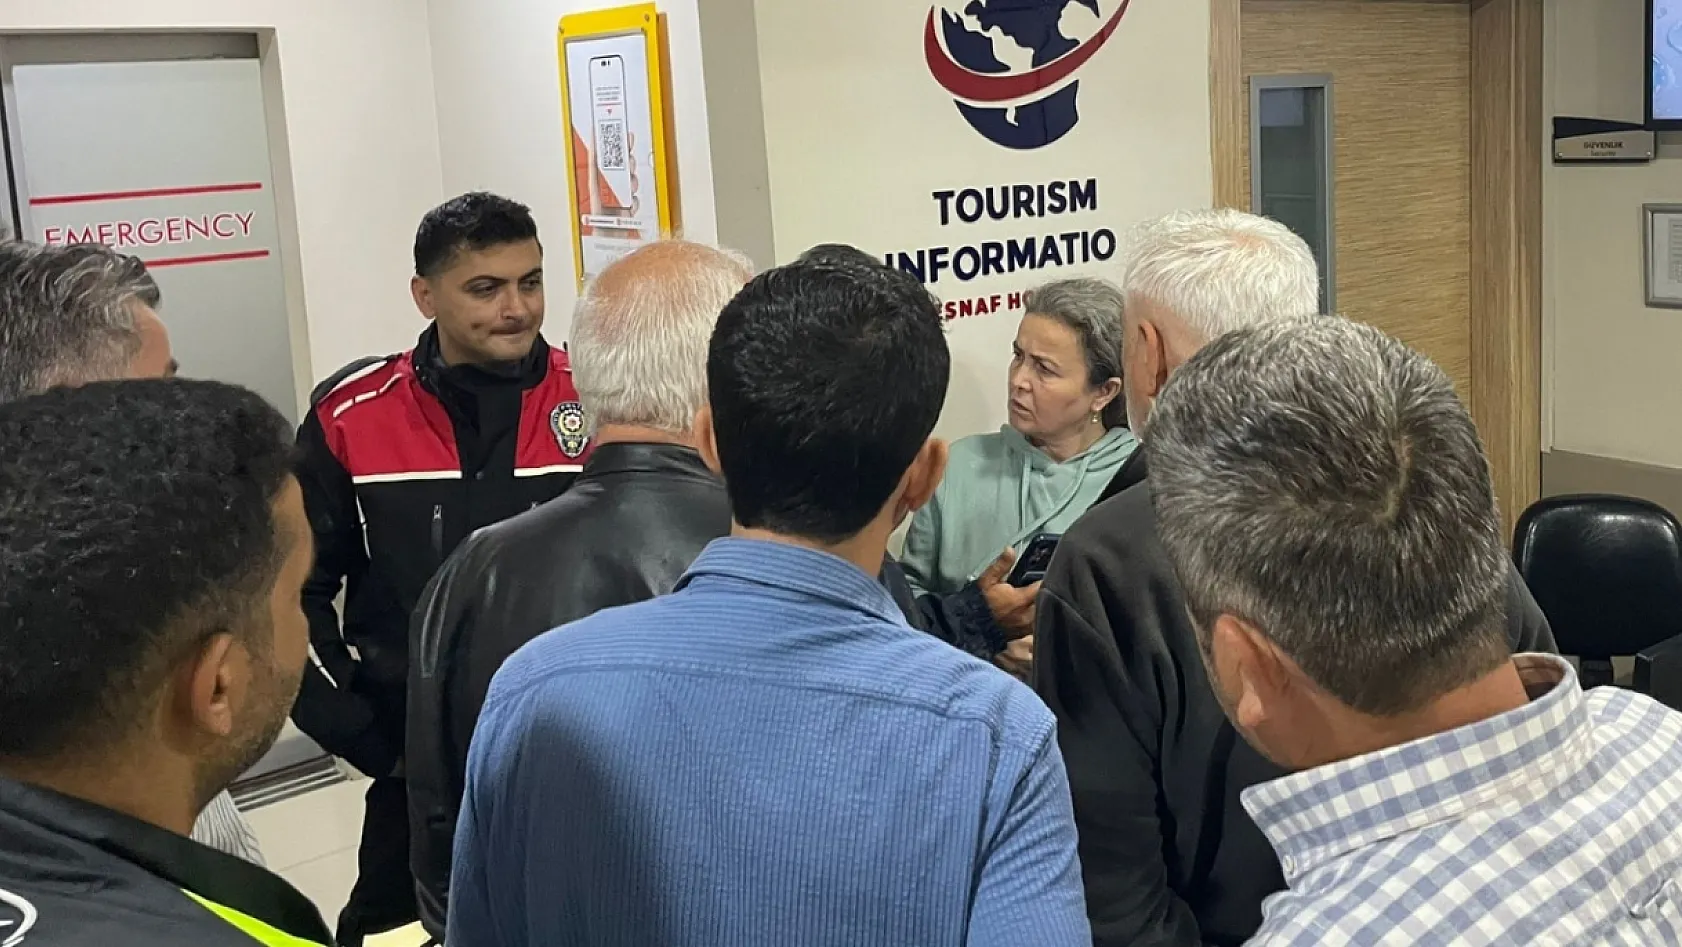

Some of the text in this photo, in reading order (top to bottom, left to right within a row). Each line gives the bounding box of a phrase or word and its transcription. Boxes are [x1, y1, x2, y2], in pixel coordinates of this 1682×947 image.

[931, 178, 1097, 226] TOURISM
[45, 211, 254, 247] EMERGENCY
[885, 228, 1117, 284] NFORMATIO
[940, 294, 1001, 322] SNAF
